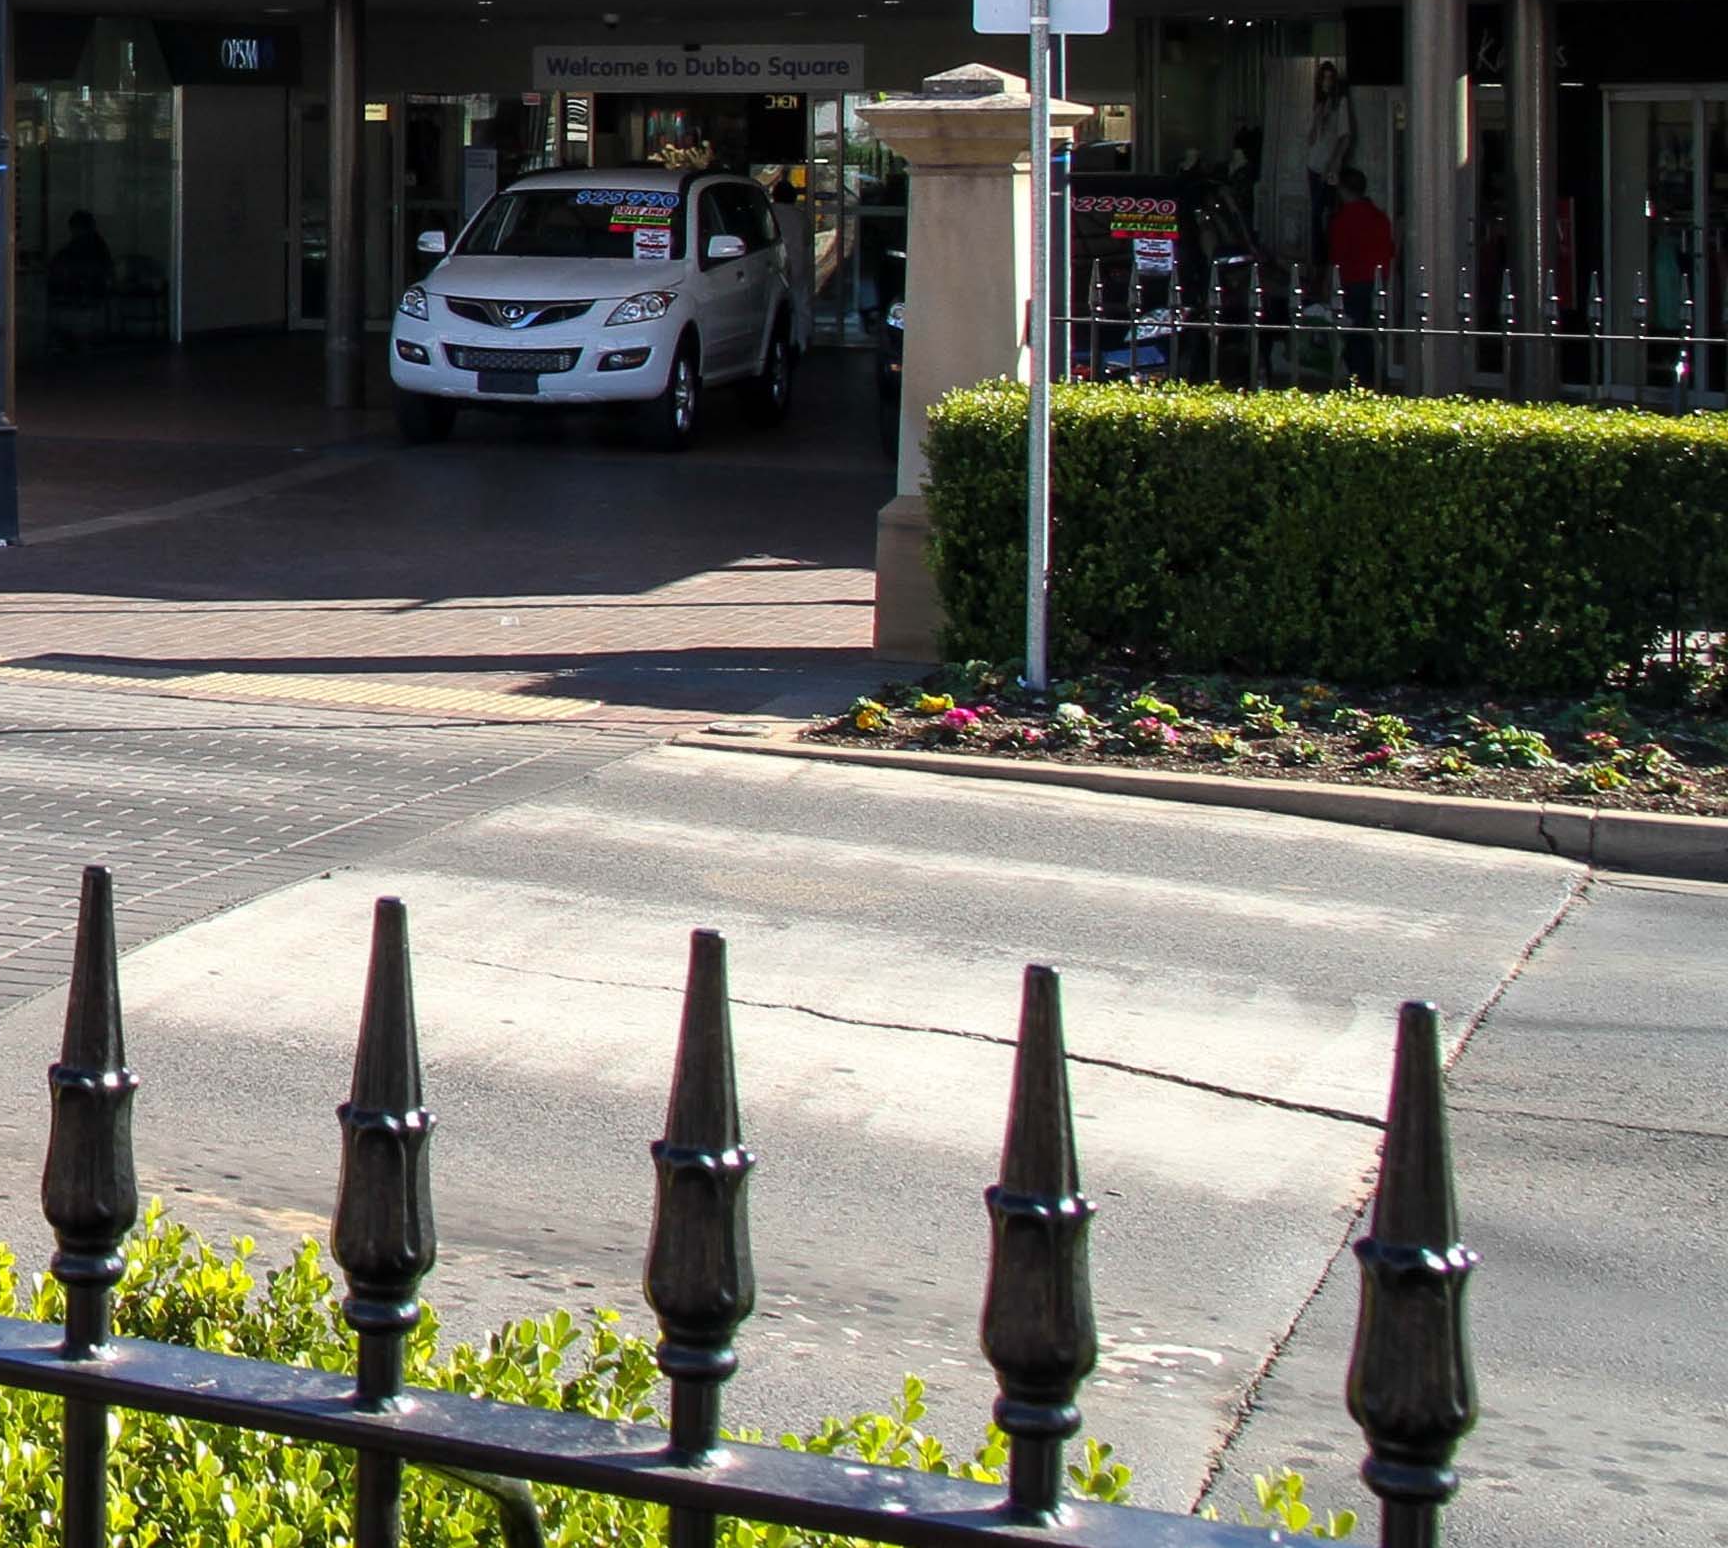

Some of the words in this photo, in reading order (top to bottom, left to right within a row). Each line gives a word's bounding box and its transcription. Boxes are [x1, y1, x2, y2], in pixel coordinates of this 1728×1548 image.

[221, 38, 258, 69] OPSM
[547, 56, 649, 77] Welcome
[655, 57, 677, 77] to
[685, 56, 761, 77] Dubbo
[768, 56, 850, 81] Square
[576, 190, 680, 208] $25990
